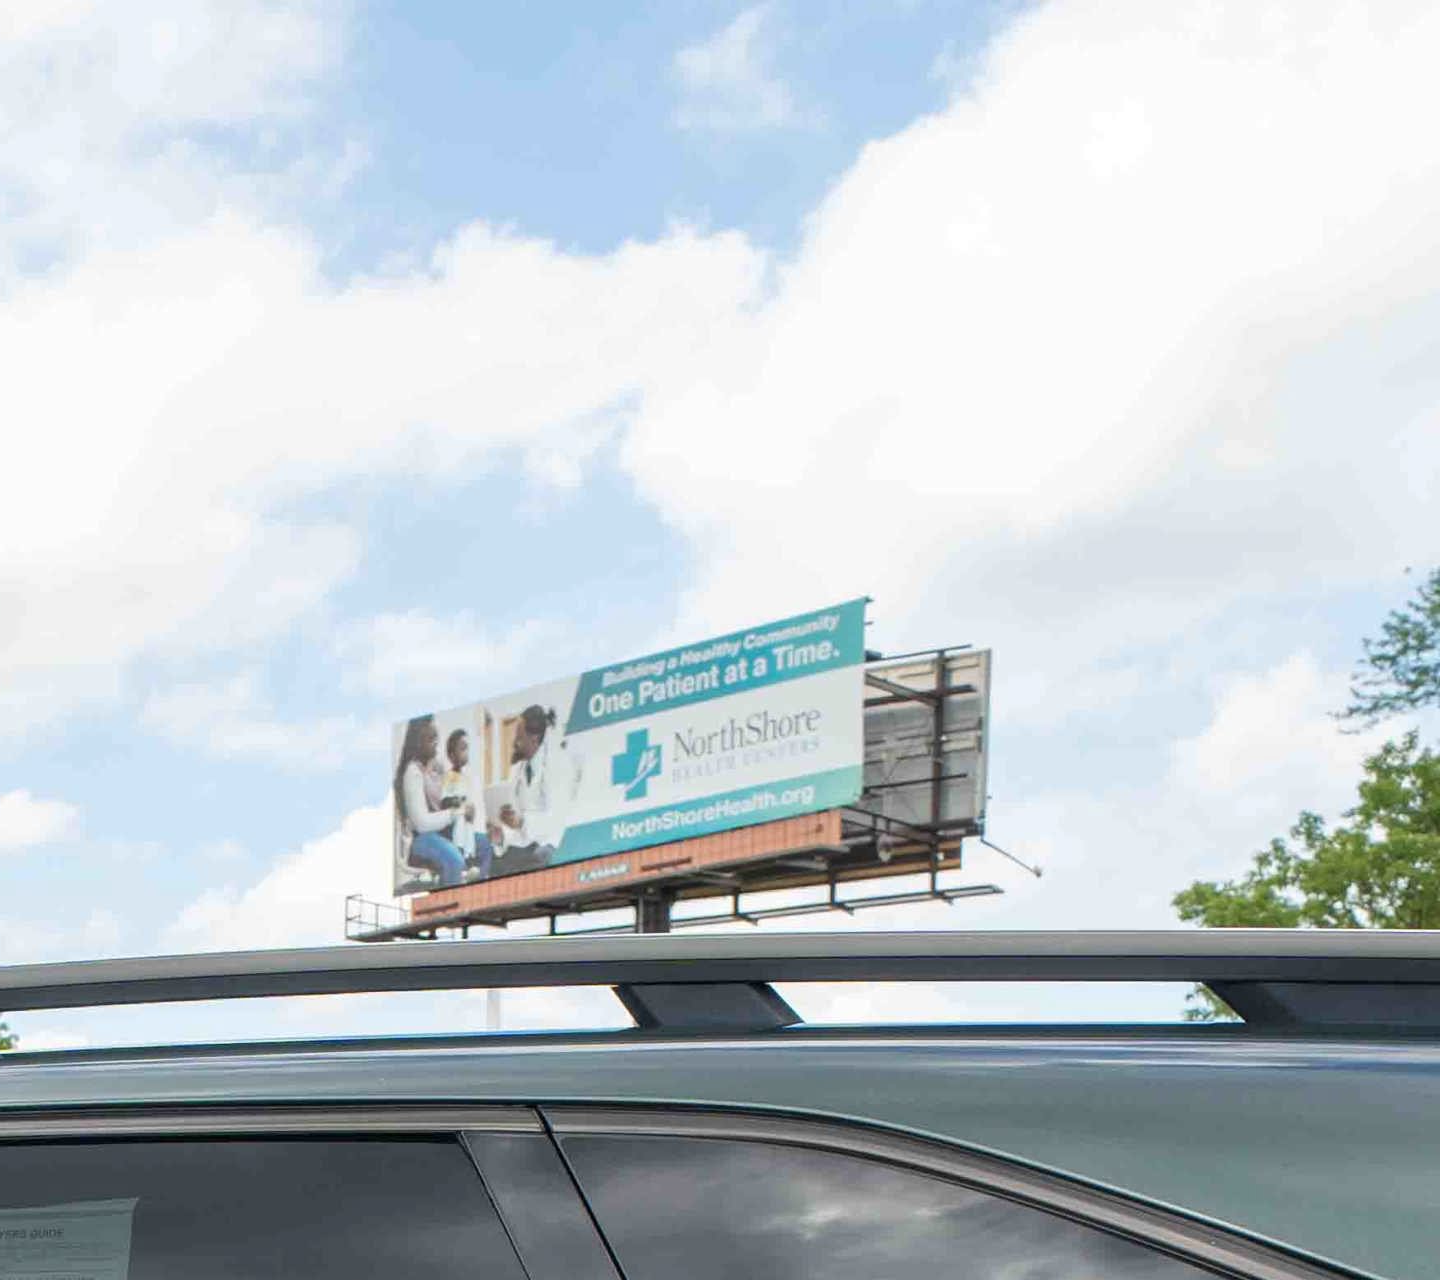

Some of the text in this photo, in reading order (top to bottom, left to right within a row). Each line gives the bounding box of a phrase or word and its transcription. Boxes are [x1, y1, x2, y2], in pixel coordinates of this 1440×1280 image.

[588, 640, 840, 717] One Patient at a Time.
[602, 614, 840, 688] Building a Healthy Community
[673, 708, 821, 763] NorthShore
[611, 785, 816, 840] NorthShoreHealth.org
[29, 1228, 64, 1240] GUIDE
